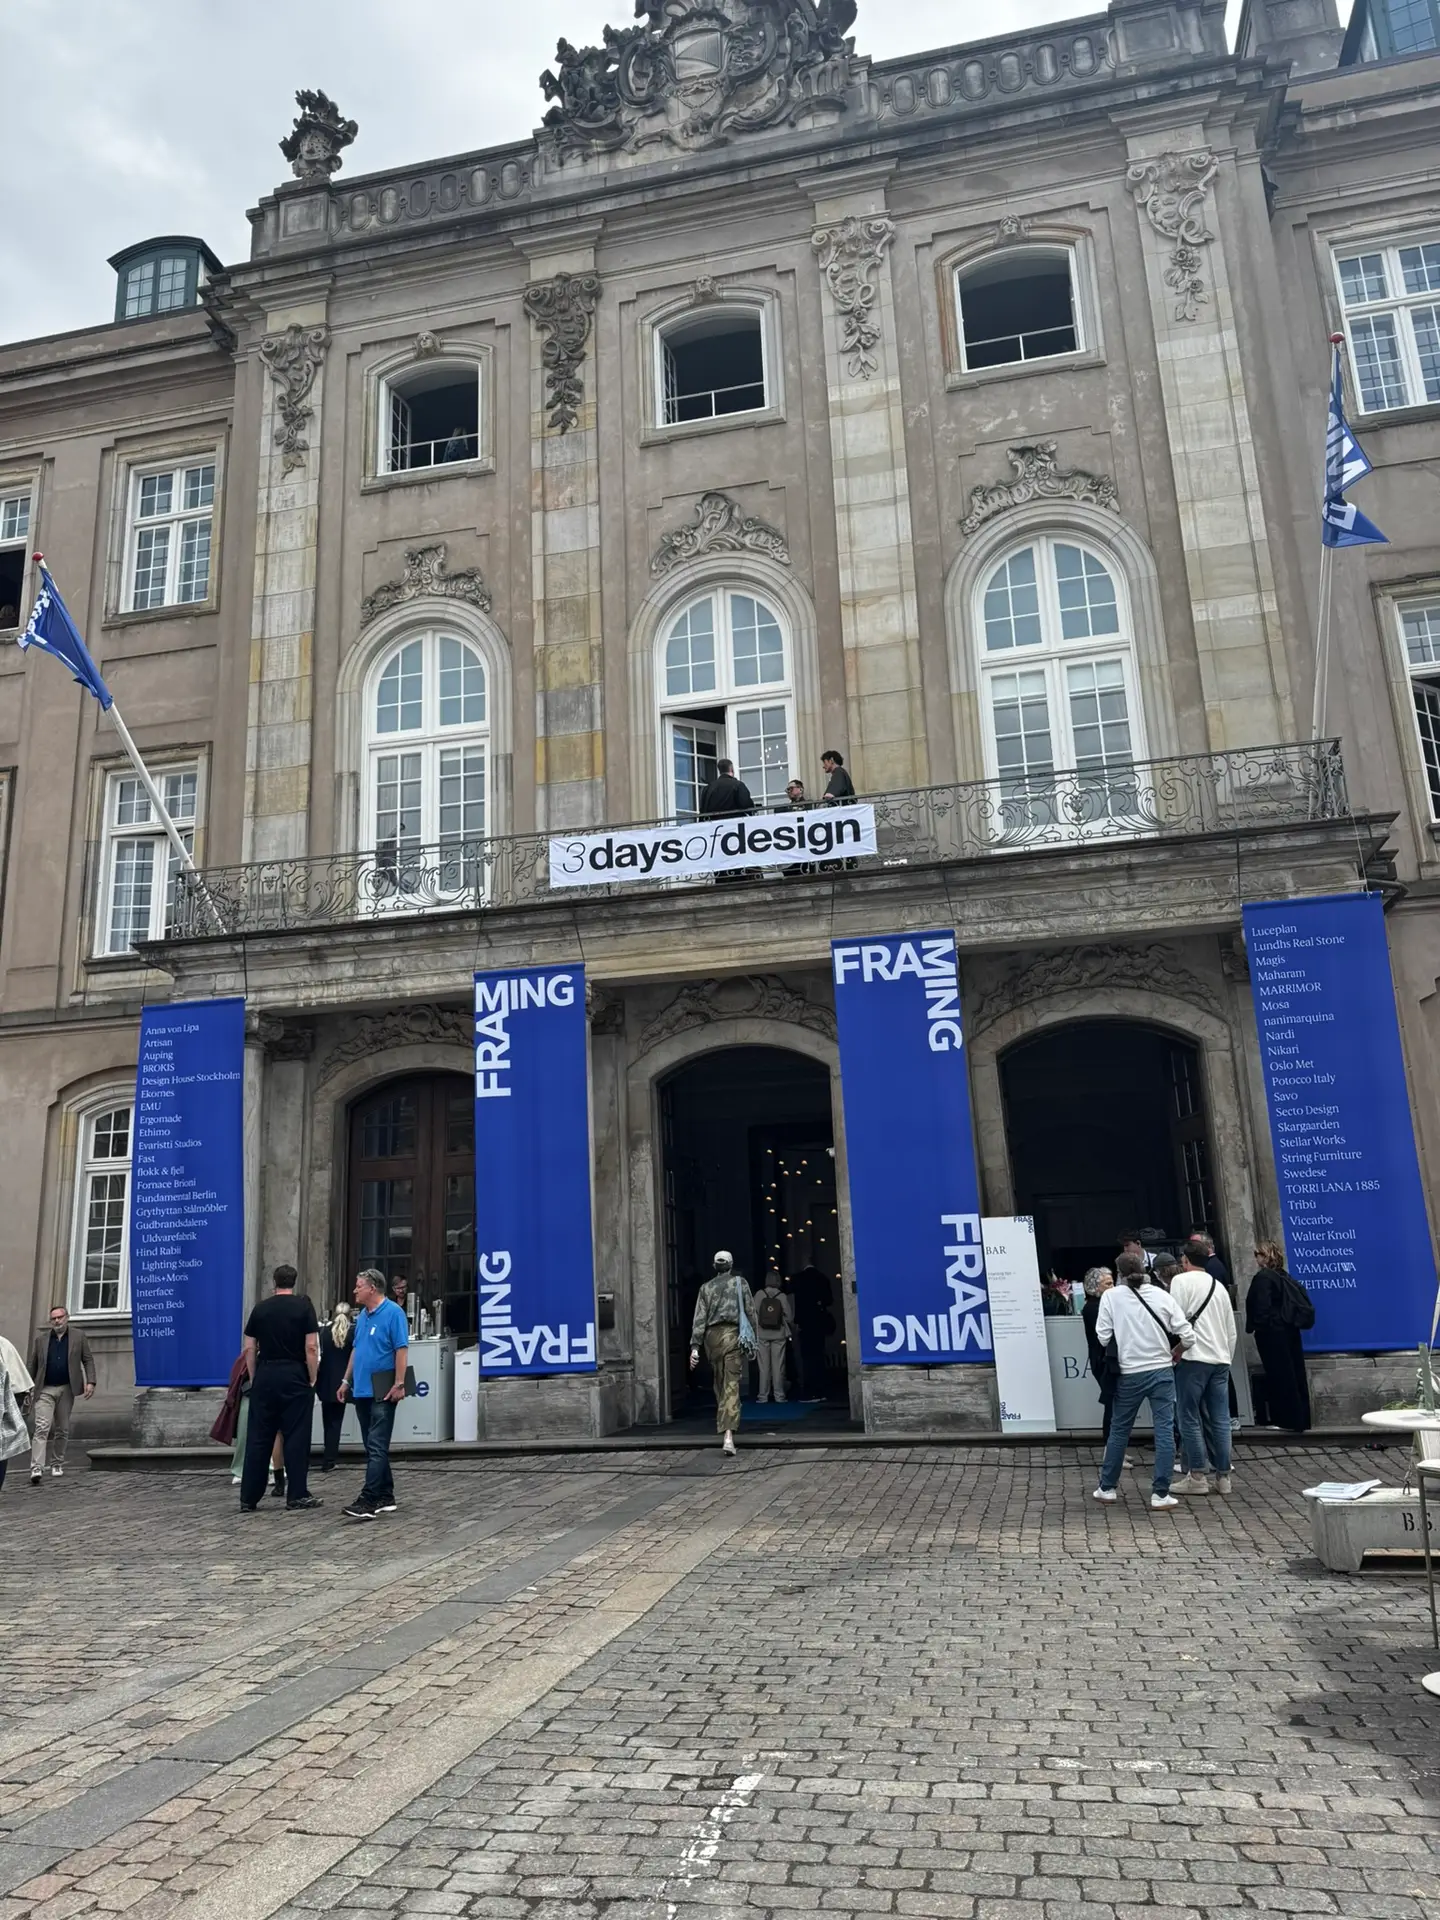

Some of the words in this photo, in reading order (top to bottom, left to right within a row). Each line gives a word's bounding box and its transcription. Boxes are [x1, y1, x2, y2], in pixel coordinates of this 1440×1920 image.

[1252, 925, 1297, 936] Luceplan
[1254, 940, 1291, 951] Lundhs
[1293, 937, 1314, 947] Real
[1316, 936, 1344, 945] Stone
[1256, 955, 1285, 967] Magis
[1258, 970, 1305, 981] Maharam
[1260, 983, 1321, 996] MARRIMOR
[1262, 1002, 1289, 1011] Mosa
[1264, 1012, 1334, 1026] nanimarquina
[183, 1024, 199, 1033] Lipa
[1266, 1029, 1294, 1041] Nardi
[143, 1051, 173, 1061] Auping
[1268, 1045, 1299, 1056] Nikari
[143, 1063, 174, 1073] BROKIS
[1270, 1061, 1293, 1071] Oslo
[1296, 1060, 1314, 1069] Met
[142, 1077, 169, 1086] Design
[172, 1076, 195, 1084] House
[196, 1072, 240, 1081] Stockholm
[1272, 1077, 1311, 1086] Potocco
[1314, 1073, 1335, 1084] Italy
[1274, 1093, 1298, 1101] Savo
[141, 1103, 161, 1111] EMU
[1276, 1108, 1303, 1116] Secto
[1305, 1105, 1339, 1116] Design
[140, 1114, 182, 1125] Ergomade
[1278, 1120, 1339, 1132] Skargaarden
[139, 1128, 170, 1136] Ethimo
[139, 1141, 172, 1150] Evaristti
[175, 1139, 202, 1148] Studios
[1280, 1137, 1311, 1147] Stellar
[1312, 1135, 1346, 1145] Works
[138, 1155, 154, 1163] Fast
[1282, 1153, 1312, 1164] String
[1314, 1151, 1361, 1161] Furniture
[138, 1167, 159, 1176] flokk
[161, 1167, 168, 1175] &
[1284, 1168, 1326, 1178] Swedese
[174, 1178, 196, 1188] Brioni
[1285, 1184, 1319, 1194] TORRI
[1321, 1182, 1352, 1192] LANA
[1356, 1180, 1380, 1190] 1885
[137, 1192, 191, 1203] Fundamental
[192, 1191, 216, 1199] Berlin
[136, 1207, 182, 1217] Grythyttan
[136, 1219, 208, 1230] Gudbrandsdalens
[1290, 1215, 1333, 1225] Viccarbe
[1292, 1231, 1325, 1241] Walter
[1327, 1230, 1355, 1240] Knoll
[136, 1247, 157, 1256] Hind
[986, 1245, 1007, 1255] BAR
[1294, 1247, 1353, 1257] Woodnotes
[142, 1260, 177, 1271] Lighting
[178, 1259, 202, 1267] Studio
[1296, 1262, 1356, 1273] YAMAGIWA
[137, 1287, 173, 1297] Interface
[137, 1303, 164, 1312] Jensen
[166, 1300, 184, 1308] Beds
[138, 1315, 172, 1325] Lapalma
[138, 1329, 149, 1337] LK
[151, 1328, 175, 1337] Hjelle
